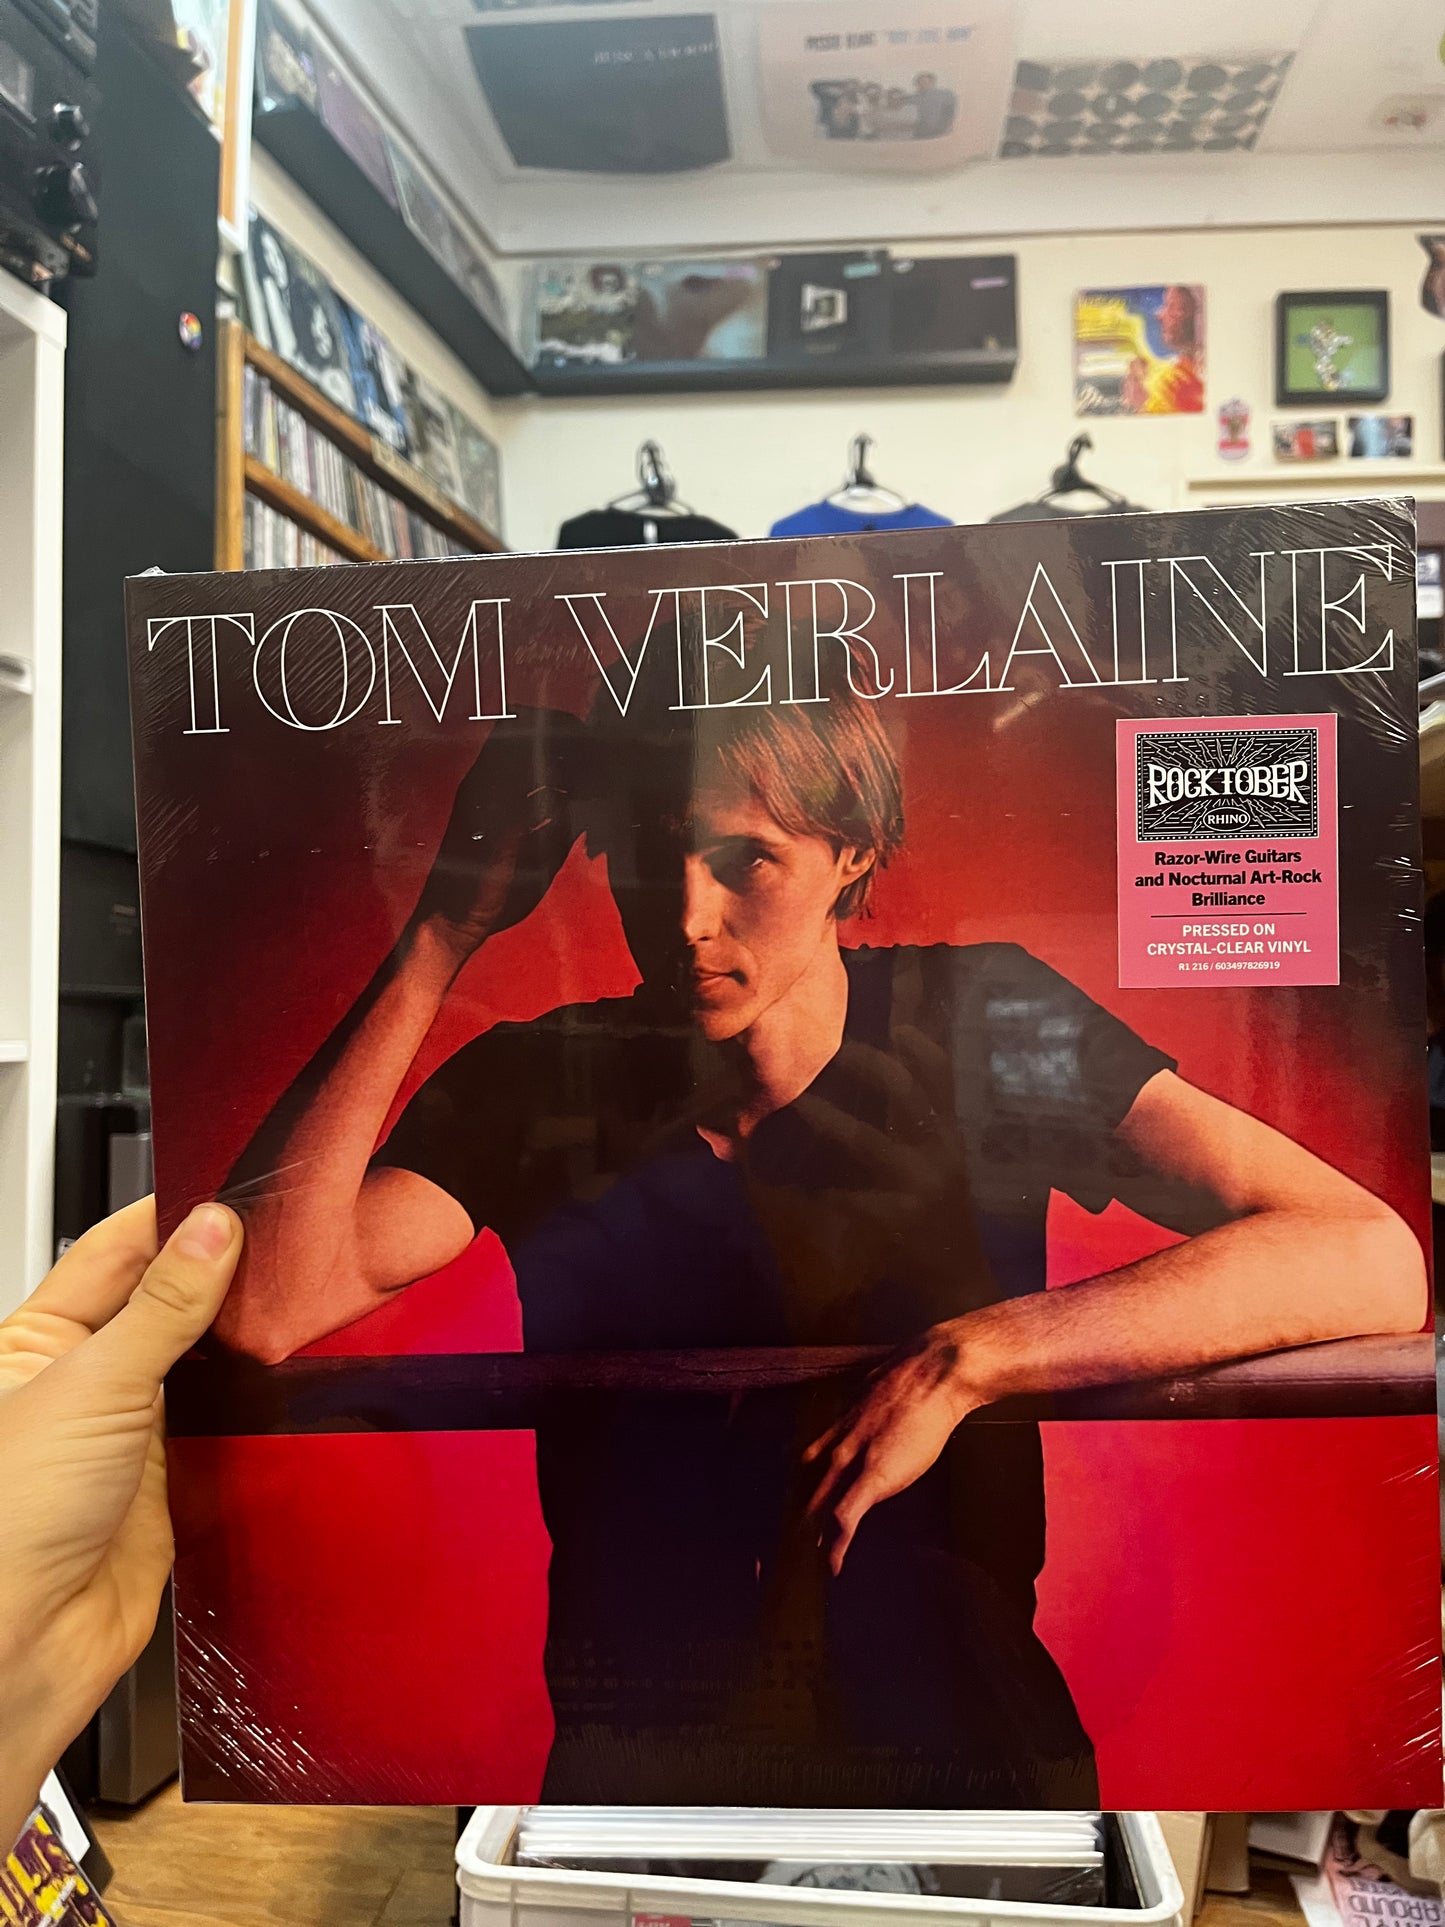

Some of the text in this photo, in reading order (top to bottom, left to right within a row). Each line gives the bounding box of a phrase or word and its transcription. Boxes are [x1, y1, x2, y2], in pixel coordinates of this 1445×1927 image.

[147, 544, 1394, 734] TOM VERLAINE
[1147, 761, 1308, 808] ROCKTOBER
[1207, 814, 1248, 825] RHINO
[1154, 849, 1302, 866] Razor-Wire Guitars
[1134, 869, 1322, 887] and Nocturnal Art-Rock
[1192, 892, 1266, 907] Brilliance
[1182, 923, 1275, 937] PRESSED ON
[1147, 940, 1312, 956] CRYSTAL-CLEAR VINYL
[1178, 962, 1190, 971] R1
[1192, 962, 1209, 971] 216
[1215, 961, 1280, 971] 603497826919
